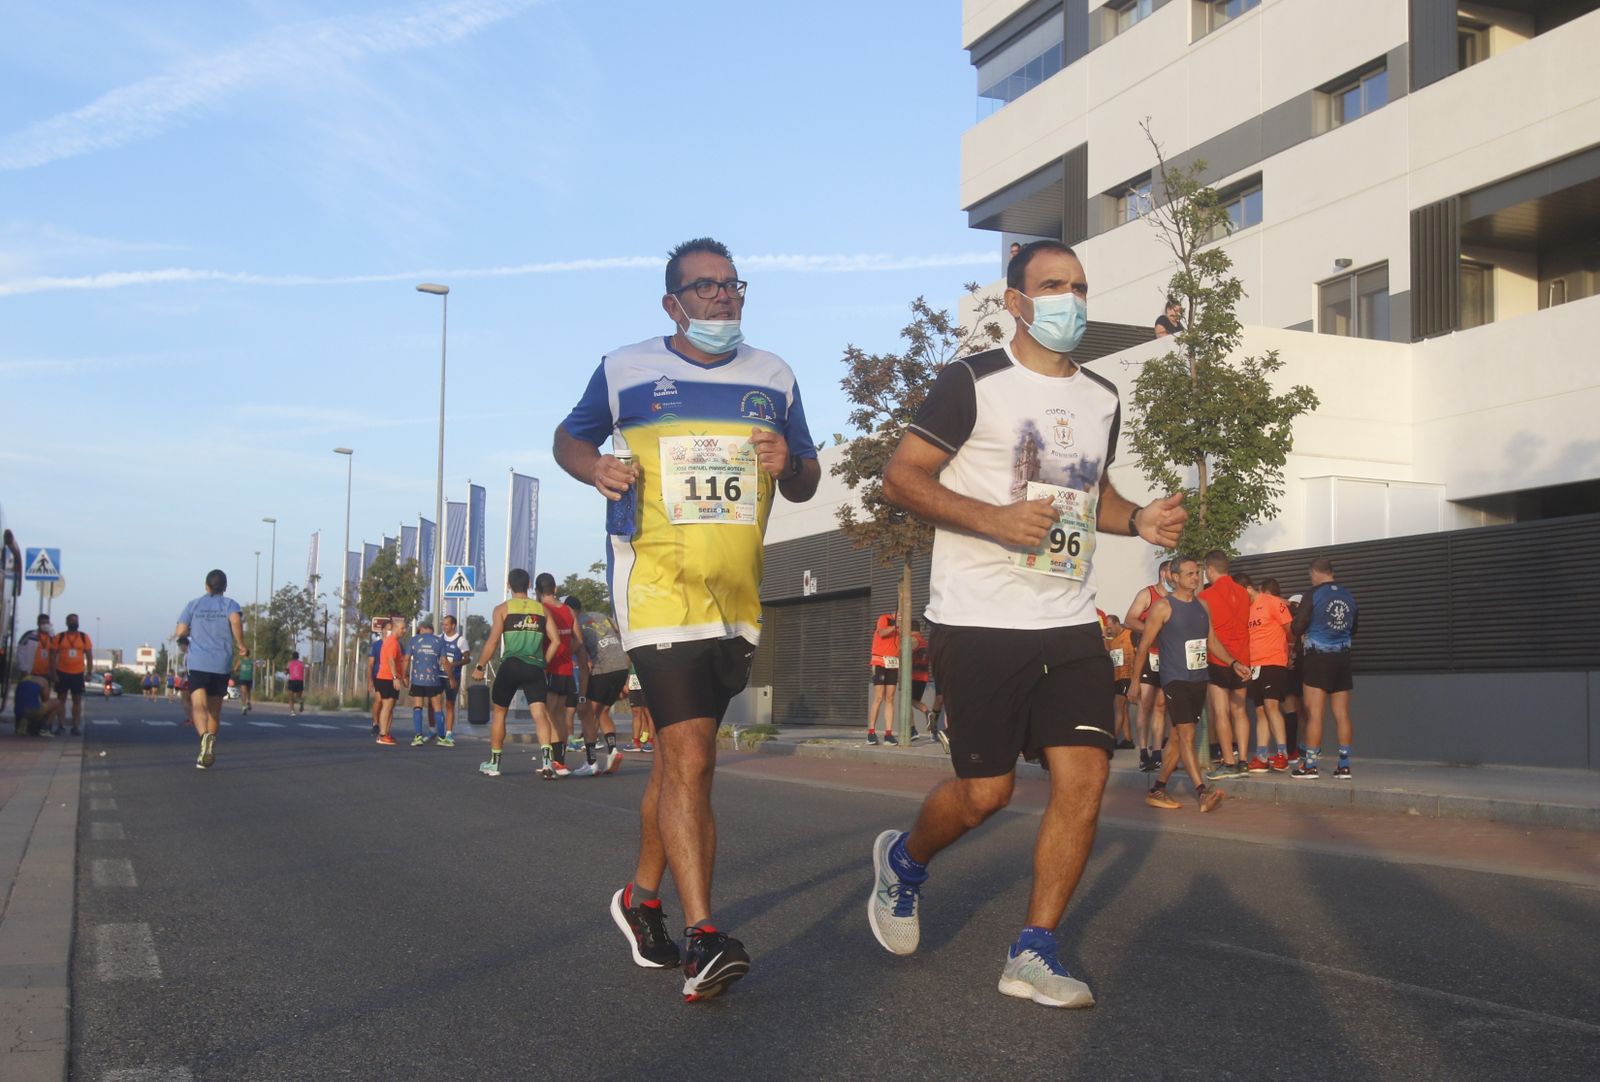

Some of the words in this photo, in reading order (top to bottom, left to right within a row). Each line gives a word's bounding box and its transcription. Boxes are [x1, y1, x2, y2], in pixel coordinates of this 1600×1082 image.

[693, 439, 719, 448] XXXV
[684, 475, 741, 501] 116
[1056, 489, 1077, 500] XXXV
[1050, 528, 1081, 557] 96
[1196, 652, 1206, 662] 75
